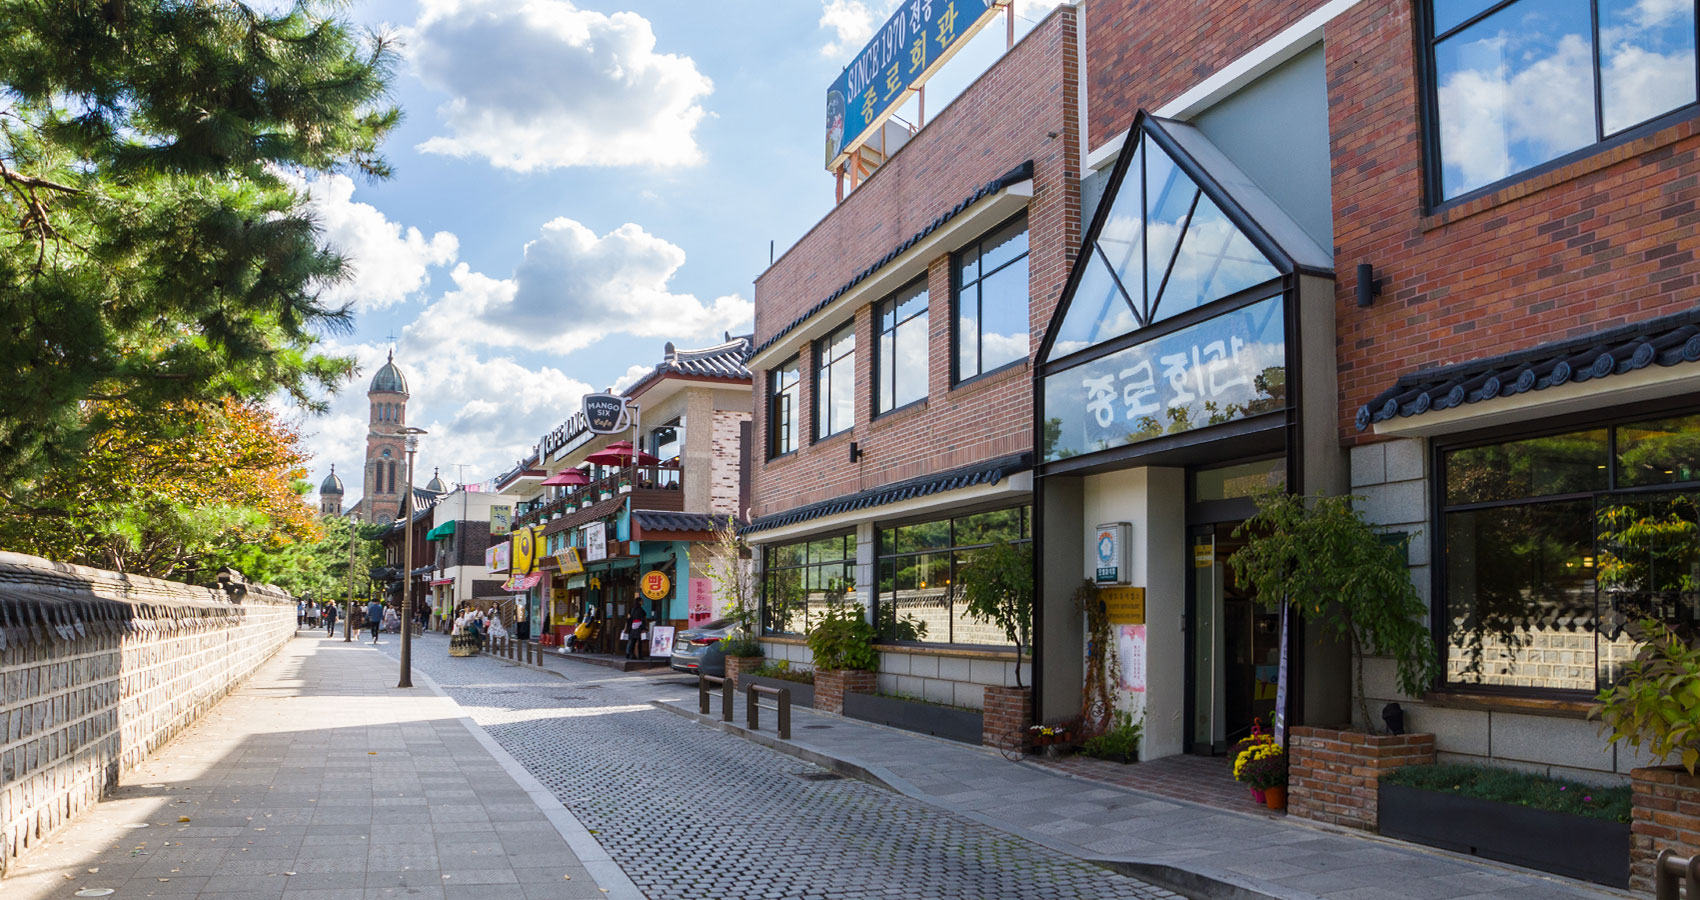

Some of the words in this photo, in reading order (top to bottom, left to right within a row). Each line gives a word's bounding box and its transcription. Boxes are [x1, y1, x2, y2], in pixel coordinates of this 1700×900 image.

[847, 42, 879, 104] SINCE
[881, 11, 905, 68] 1970
[861, 1, 959, 124] 종로회관
[587, 402, 620, 411] MANGO
[1082, 335, 1249, 428] 종로회관
[597, 409, 611, 417] SIX
[648, 575, 664, 591] 빵
